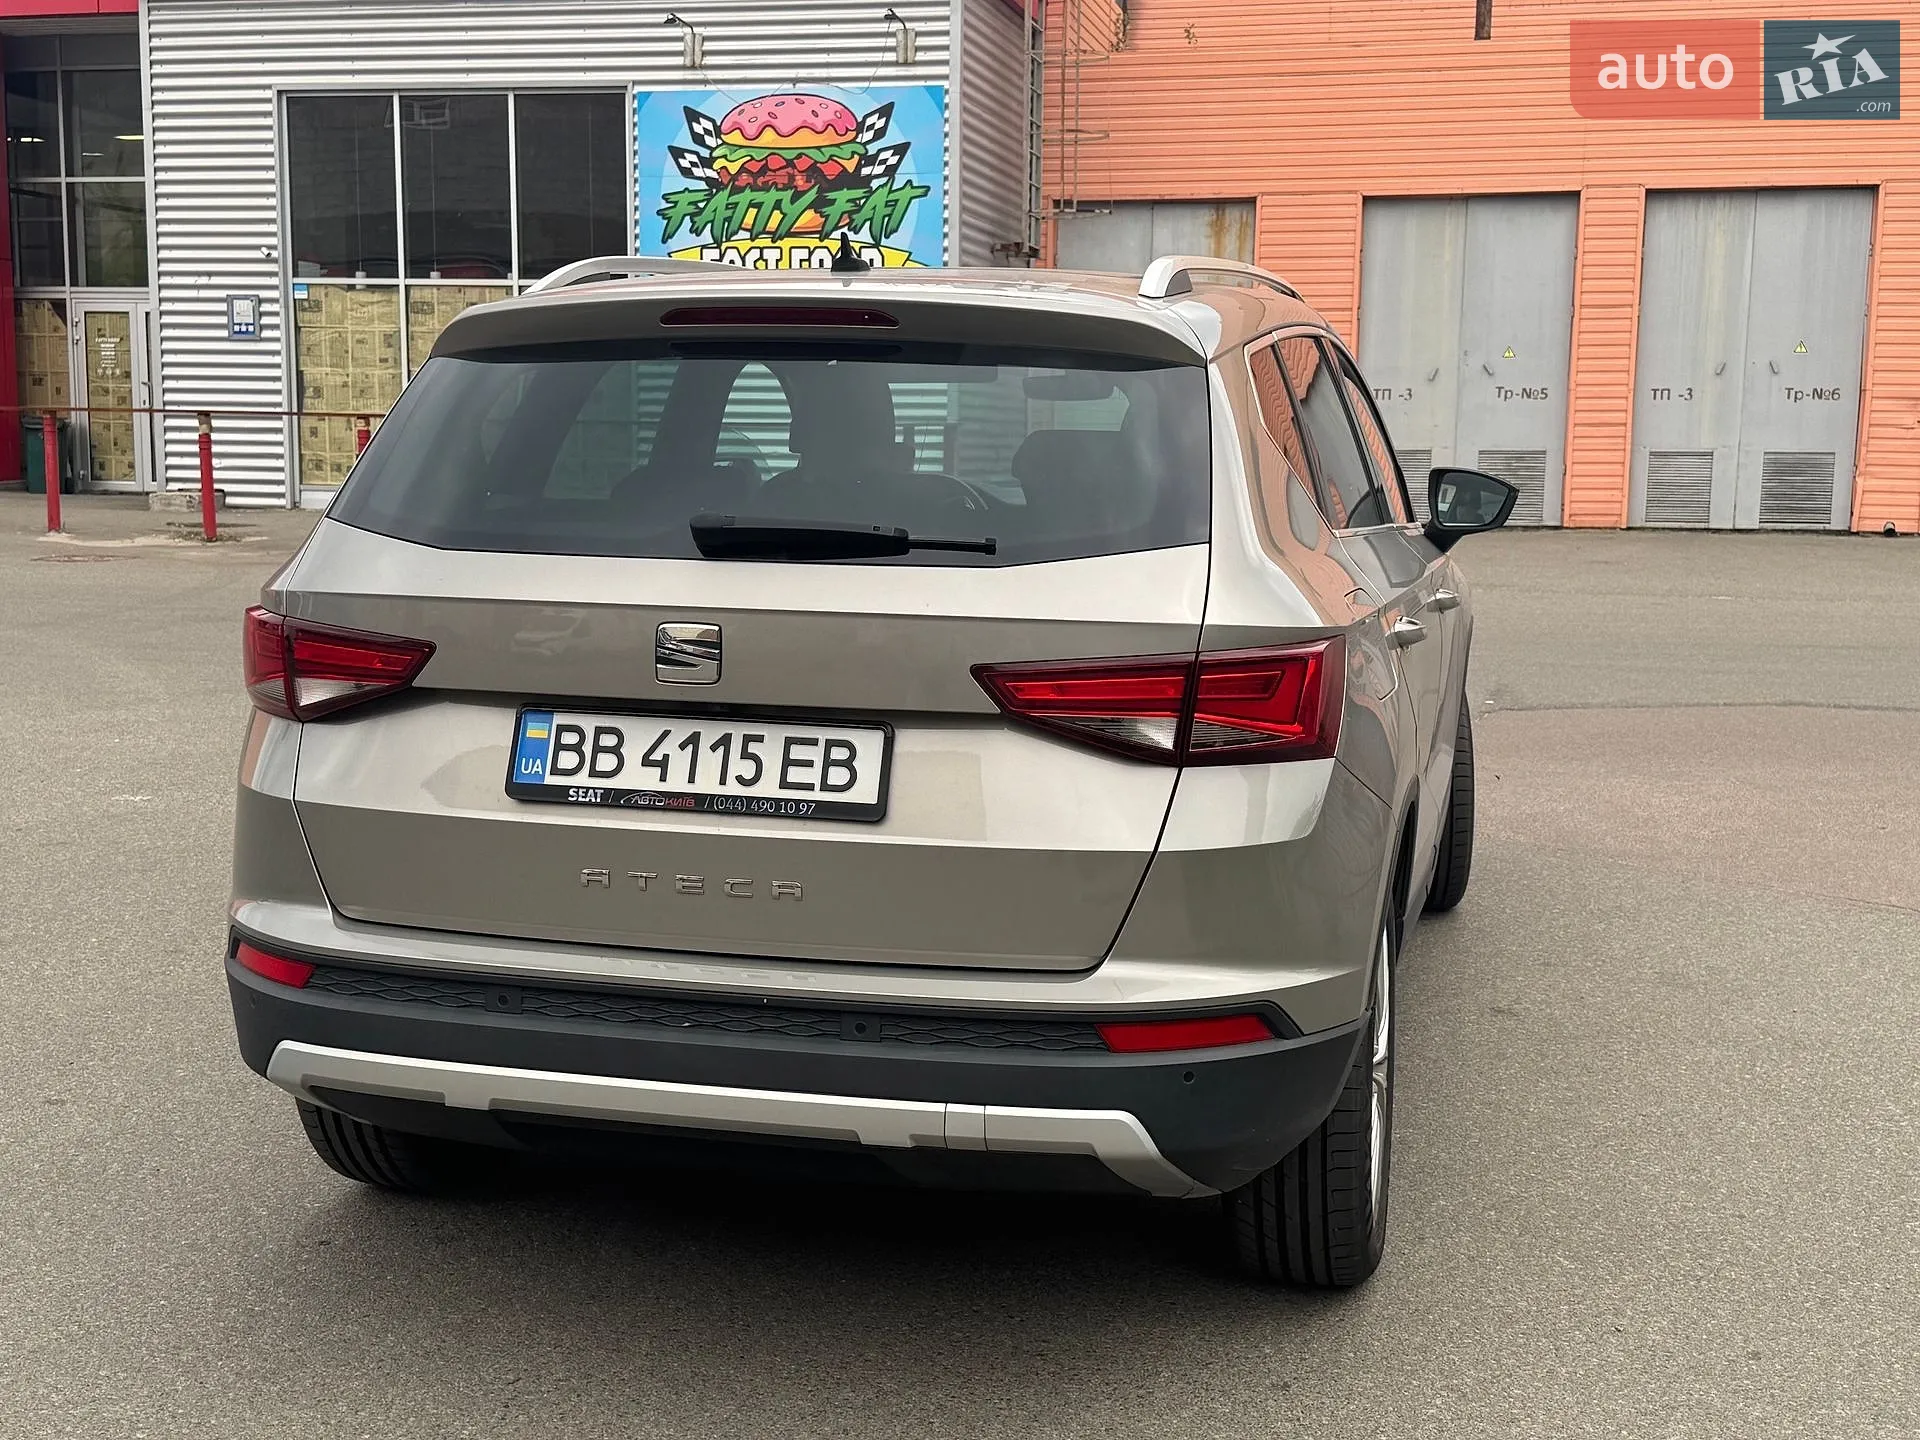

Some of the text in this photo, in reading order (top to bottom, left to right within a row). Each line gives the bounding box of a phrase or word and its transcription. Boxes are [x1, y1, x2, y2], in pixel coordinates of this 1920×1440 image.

[656, 177, 932, 248] FATTY FAT
[521, 757, 543, 775] UA
[550, 724, 858, 793] BB 4115 EB
[568, 787, 604, 803] SEAT
[713, 796, 747, 812] (044)
[750, 799, 776, 814] 490
[779, 801, 796, 814] 10
[799, 802, 816, 815] 97
[580, 867, 804, 901] ATECA
